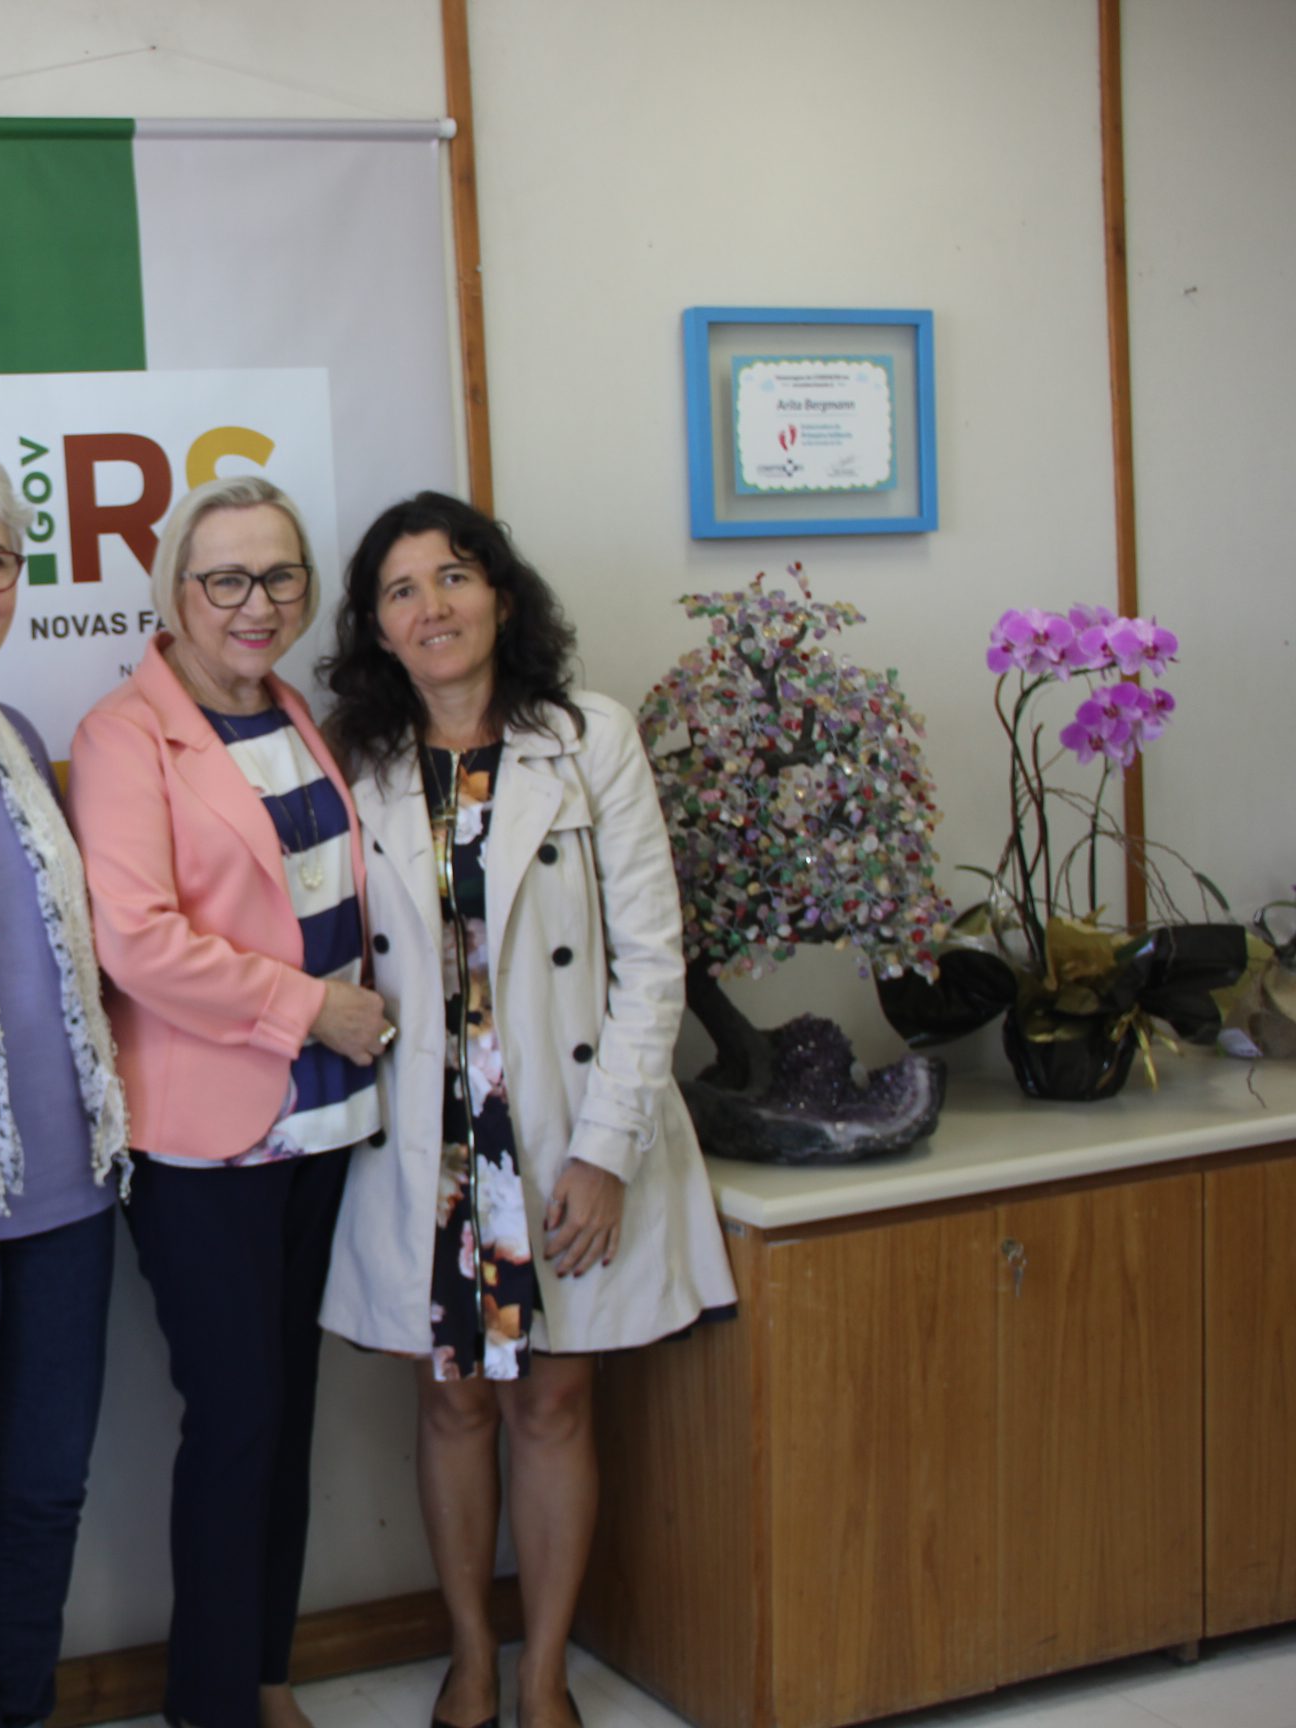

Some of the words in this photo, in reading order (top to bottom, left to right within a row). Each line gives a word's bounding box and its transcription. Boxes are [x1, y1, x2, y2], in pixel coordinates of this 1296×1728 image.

[805, 399, 855, 413] Bergmann
[18, 436, 56, 543] GOV
[30, 612, 128, 641] NOVAS
